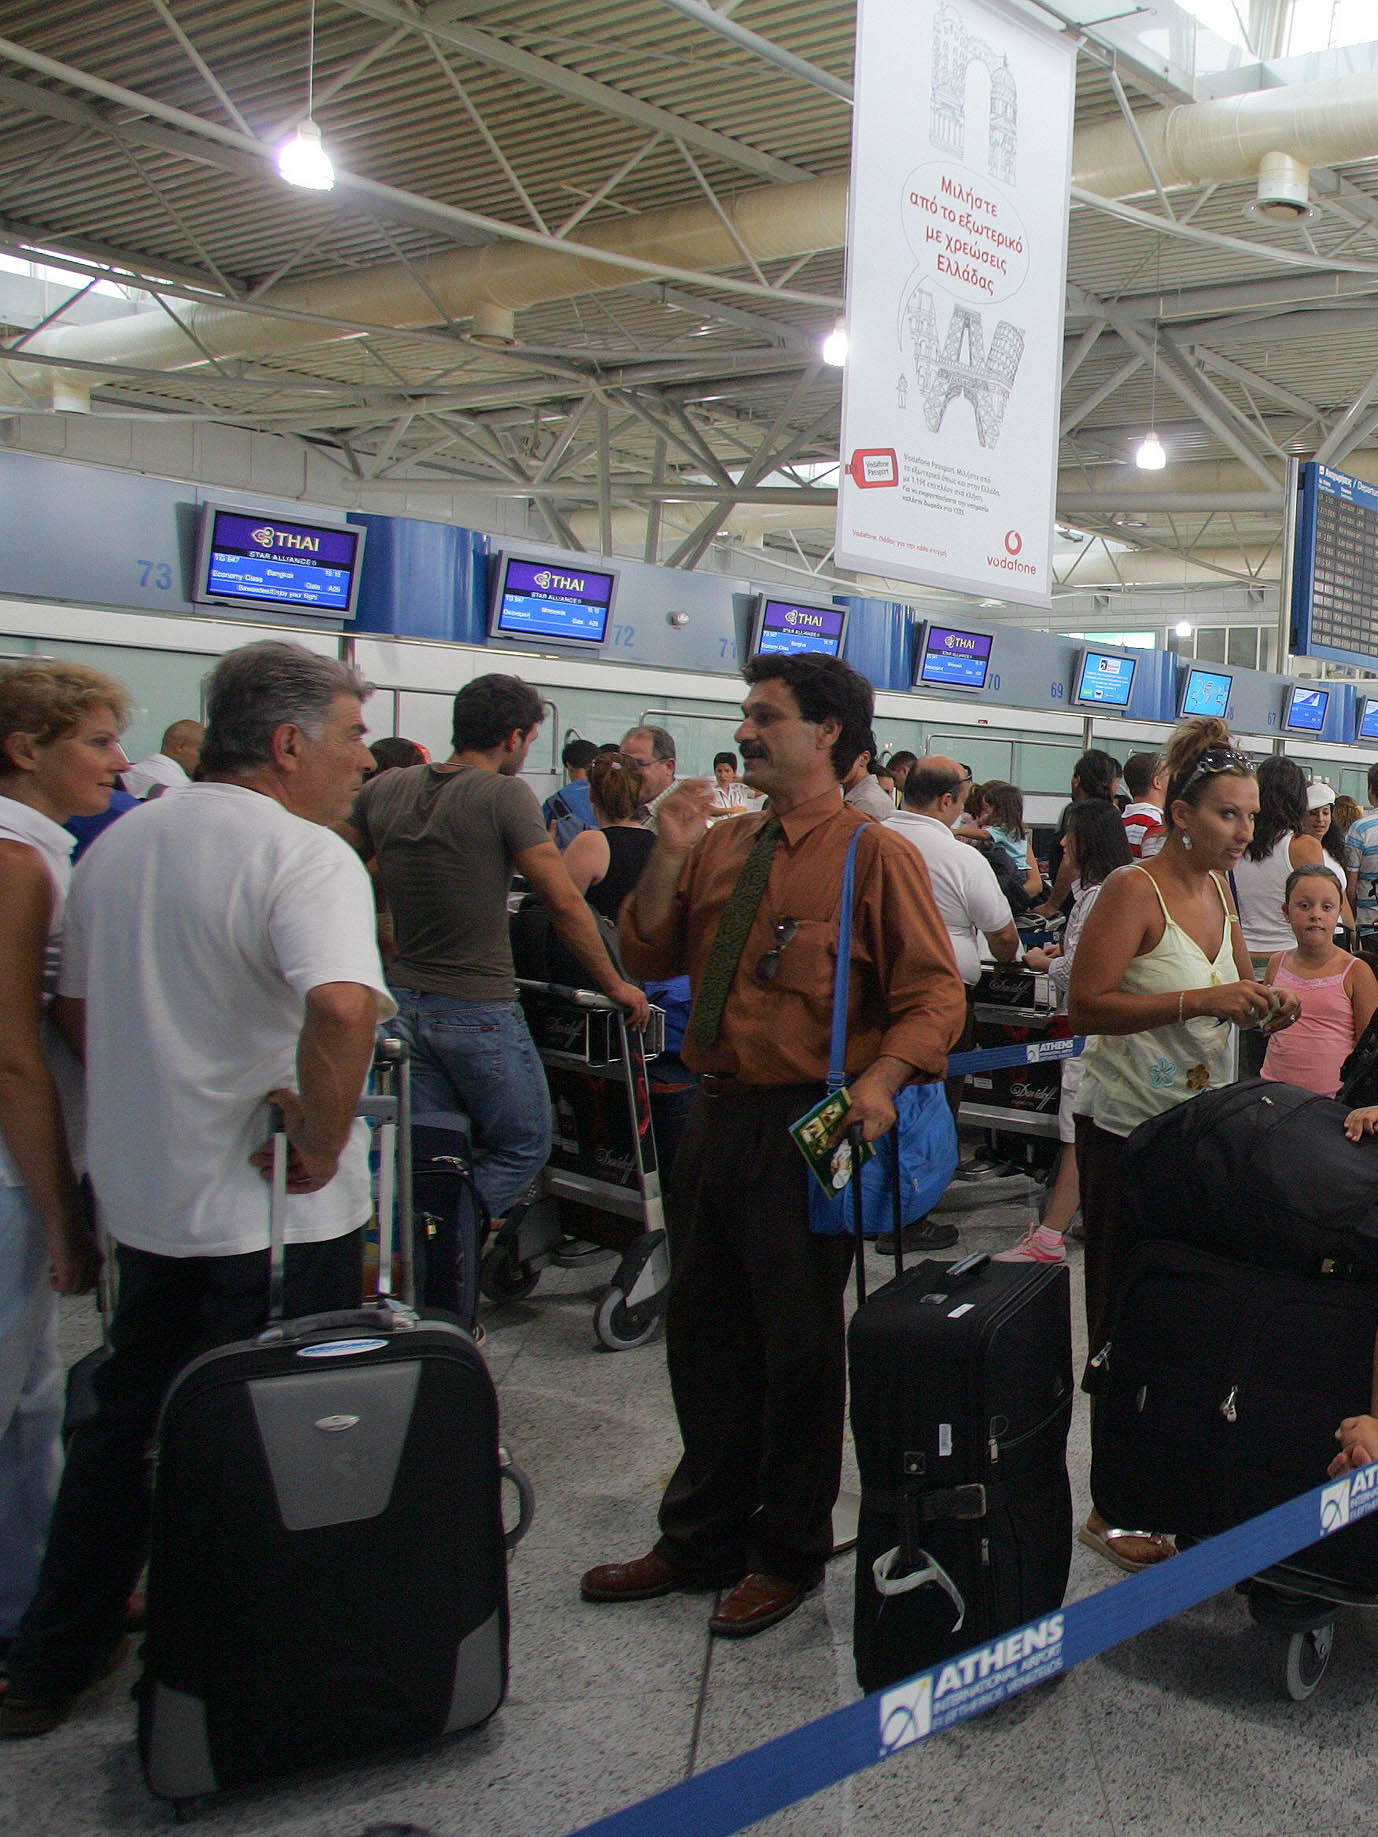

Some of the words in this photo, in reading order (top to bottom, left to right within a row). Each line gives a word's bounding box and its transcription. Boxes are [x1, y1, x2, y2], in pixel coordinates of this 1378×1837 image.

[941, 176, 998, 217] Μιλήστε
[910, 191, 938, 215] από
[941, 205, 956, 222] το
[959, 213, 1023, 253] εξωτερικό
[926, 223, 943, 244] με
[945, 234, 1007, 275] χρεώσεις
[937, 254, 994, 296] Ελλάδας
[275, 532, 320, 551] THAI
[136, 559, 173, 590] 73
[987, 555, 1037, 575] vodafone
[551, 575, 585, 592] THAI
[798, 613, 824, 627] THAI
[613, 624, 635, 647] 72
[955, 637, 975, 649] THAI
[720, 638, 736, 659] 71
[988, 673, 1001, 691] 70
[1051, 681, 1064, 698] 69
[1040, 1040, 1073, 1051] ATHENS
[934, 1613, 1065, 1700] ATHENS
